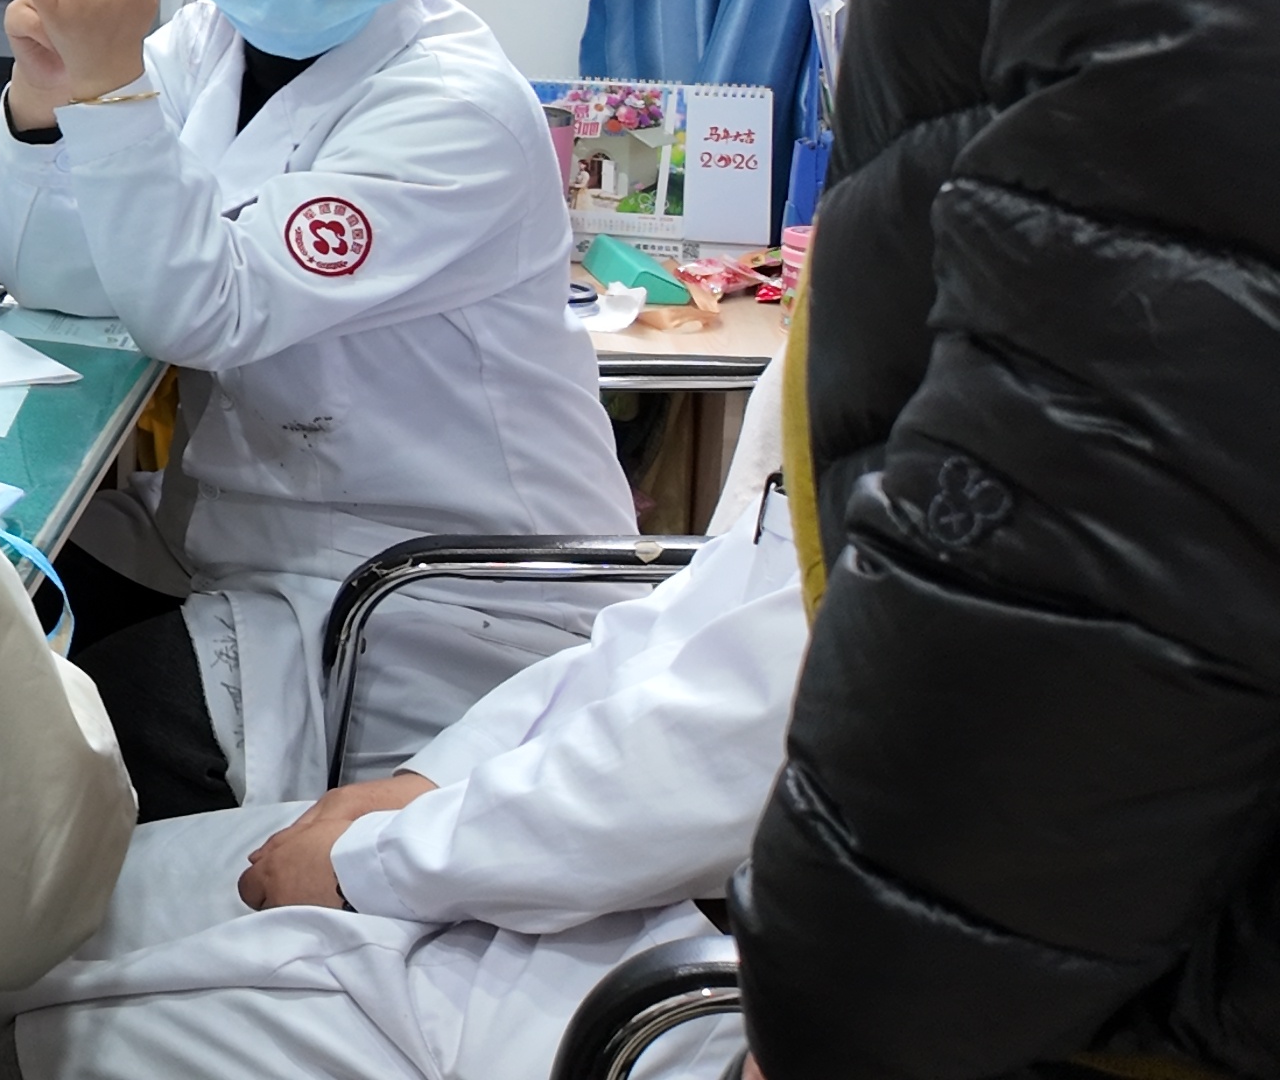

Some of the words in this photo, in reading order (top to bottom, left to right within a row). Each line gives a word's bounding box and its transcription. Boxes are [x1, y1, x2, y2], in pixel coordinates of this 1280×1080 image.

[704, 126, 756, 144] 马年大吉
[700, 152, 758, 170] 2026
